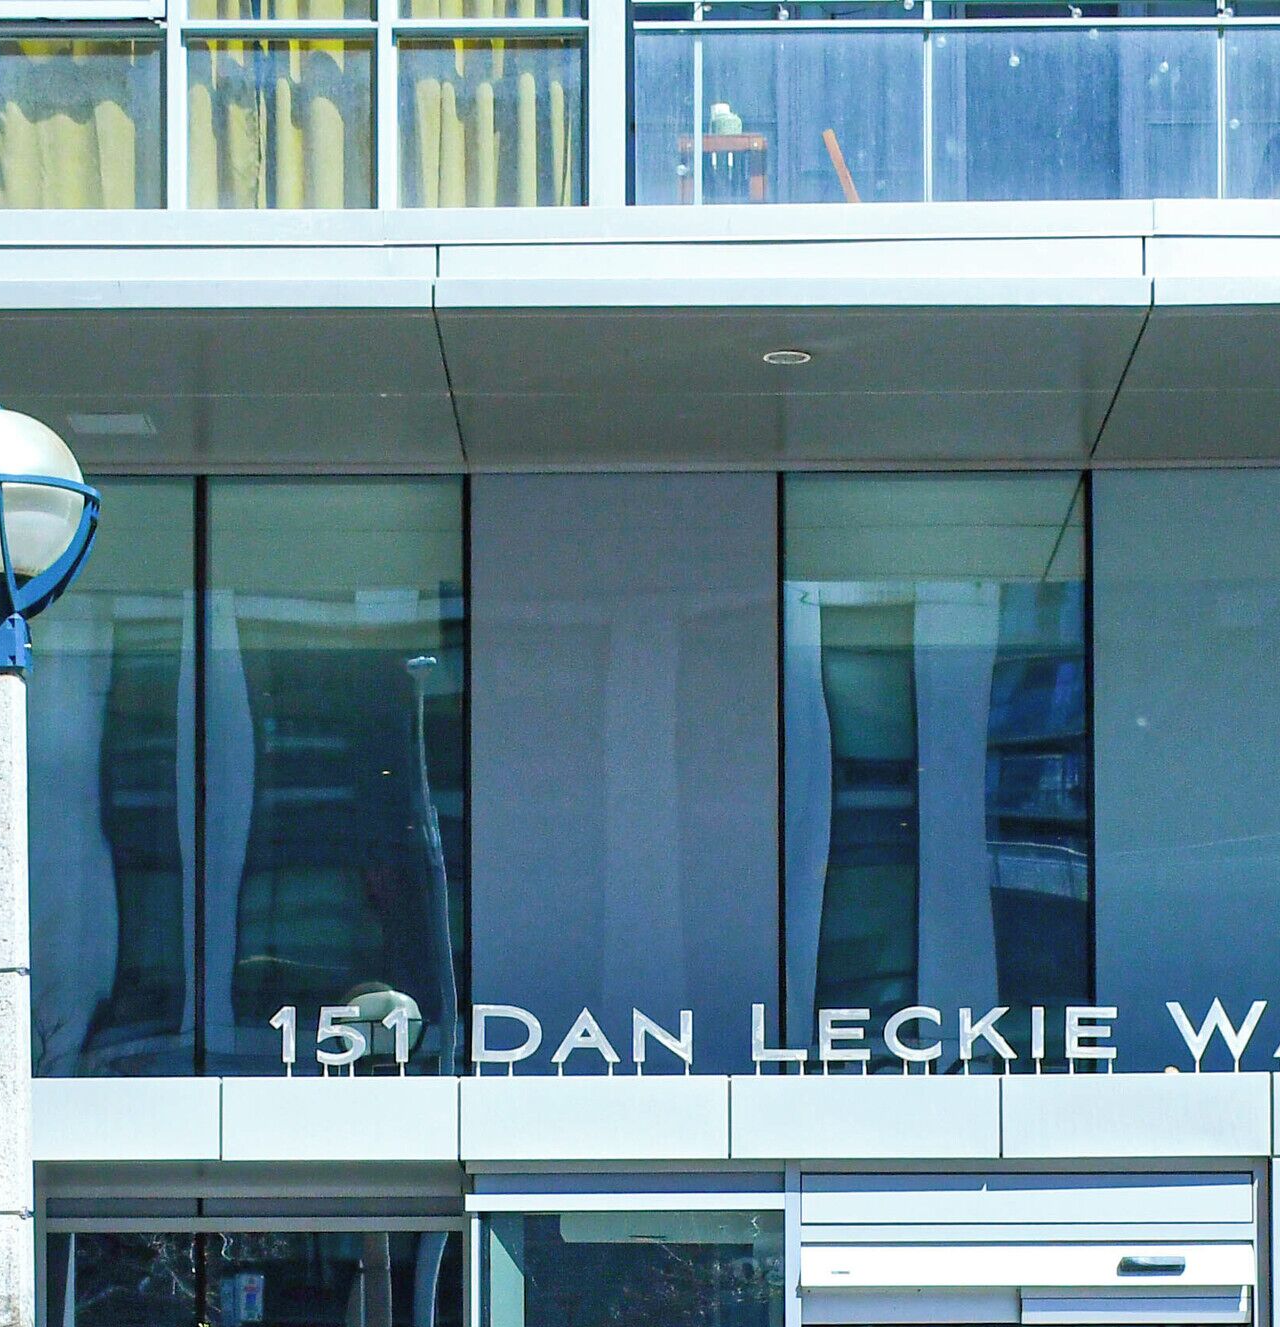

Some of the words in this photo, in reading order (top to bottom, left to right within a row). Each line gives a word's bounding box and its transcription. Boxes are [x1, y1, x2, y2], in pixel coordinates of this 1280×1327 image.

[269, 1005, 409, 1066] 151
[472, 1004, 694, 1064] DAN
[751, 1003, 1118, 1061] LECKIE
